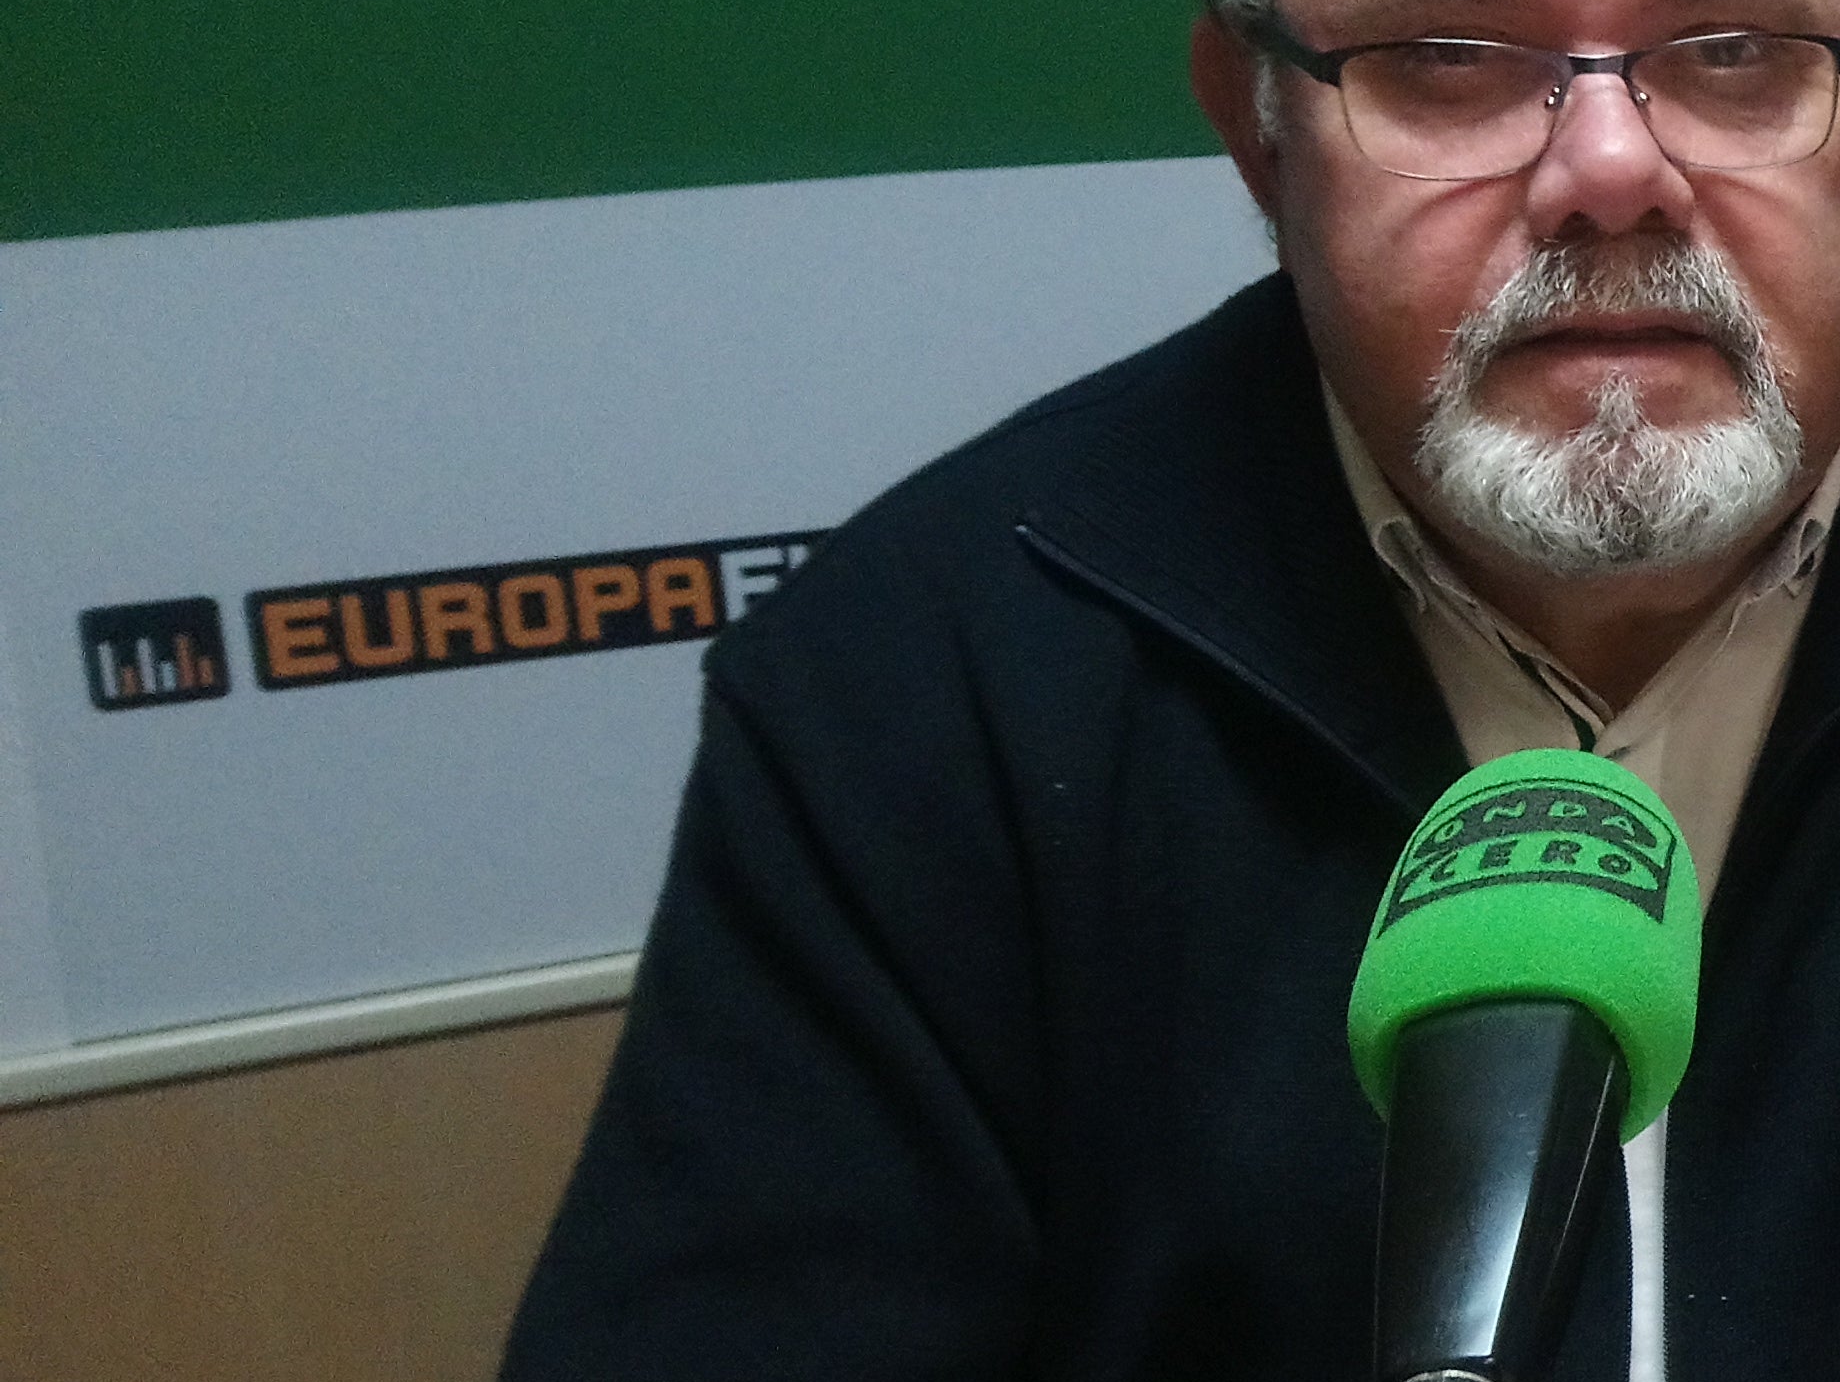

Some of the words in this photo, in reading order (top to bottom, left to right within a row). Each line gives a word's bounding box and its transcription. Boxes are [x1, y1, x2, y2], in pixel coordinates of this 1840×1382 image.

[260, 544, 810, 679] EUROPAF
[1434, 800, 1637, 839] ONDA
[1430, 839, 1632, 883] CERO
